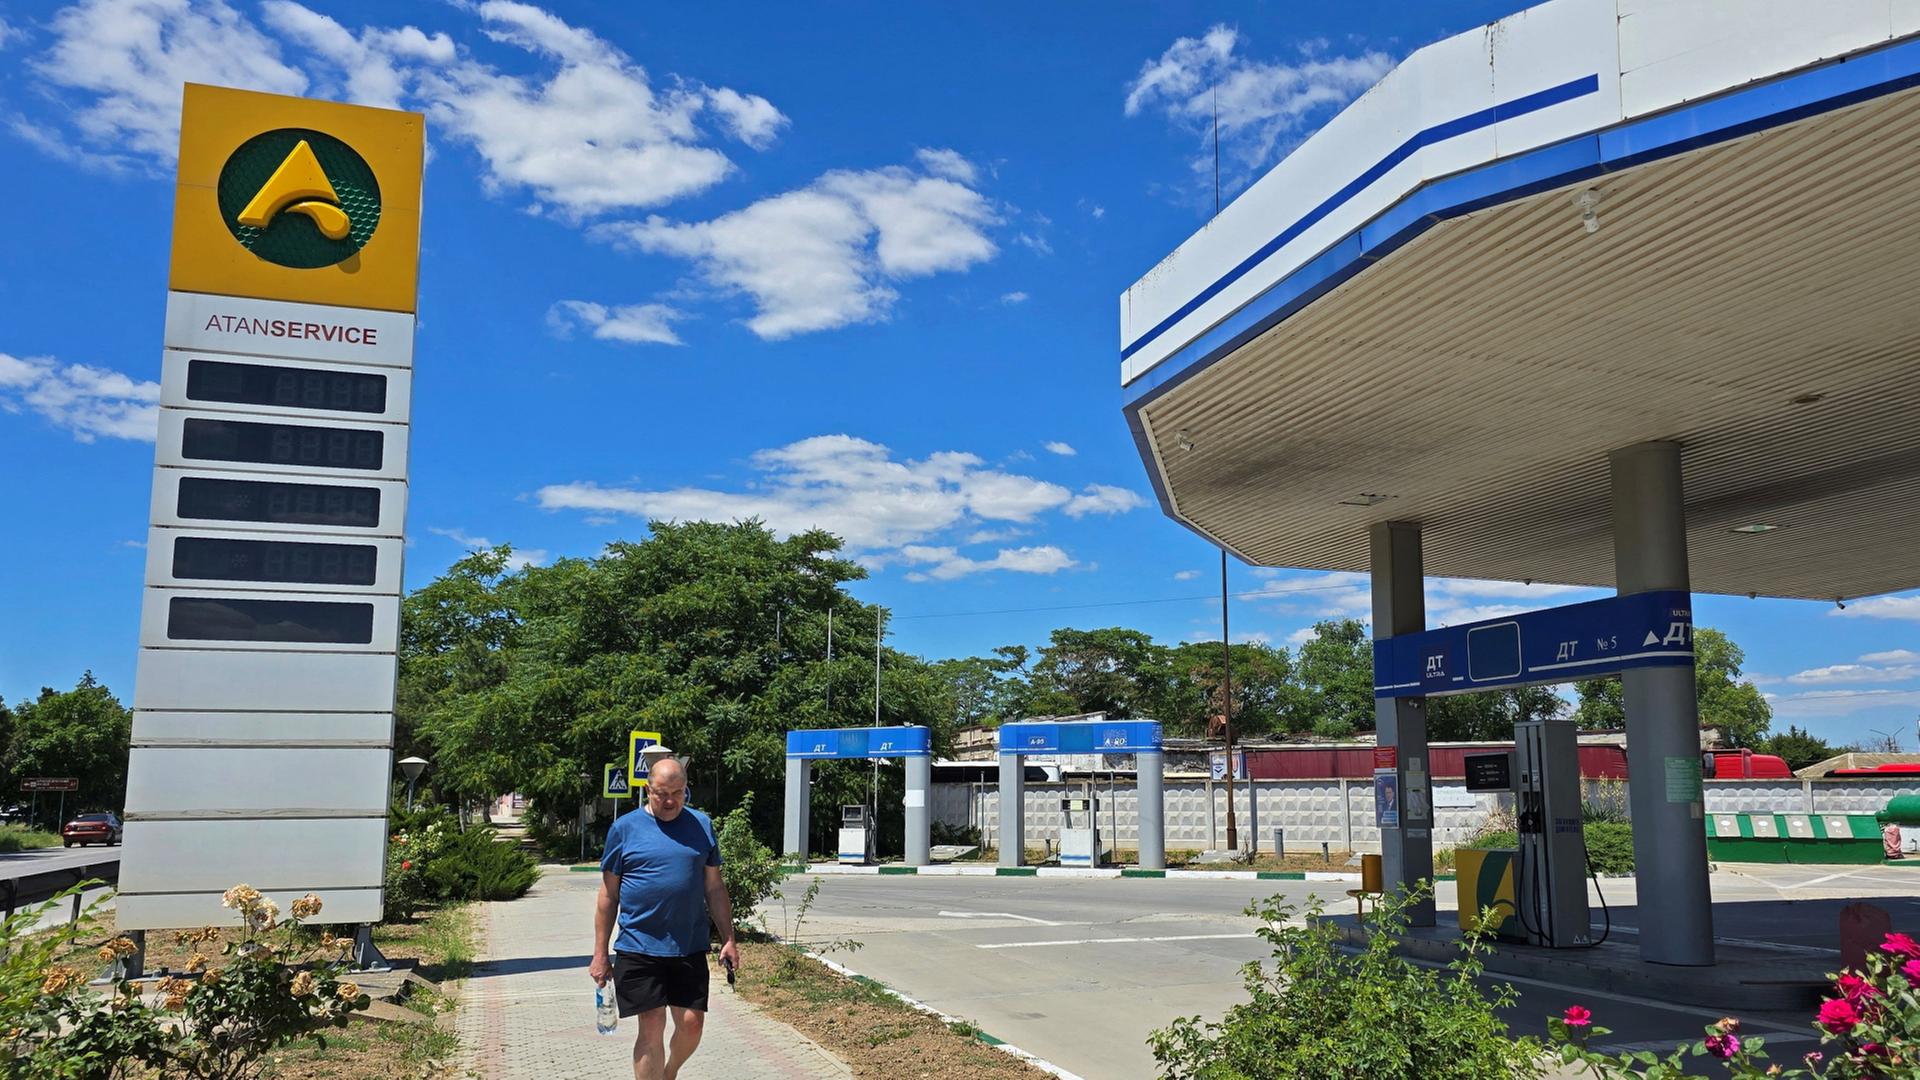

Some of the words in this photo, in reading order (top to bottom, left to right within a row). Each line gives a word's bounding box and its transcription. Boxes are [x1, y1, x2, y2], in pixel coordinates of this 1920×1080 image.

[205, 314, 377, 345] ATANSERVICE
[1556, 640, 1579, 662] ДТ
[1611, 635, 1617, 649] 5
[1426, 655, 1444, 672] ДТ
[1425, 671, 1446, 679] ULTRA
[813, 744, 827, 753] ДТ
[880, 742, 894, 751] ДТ
